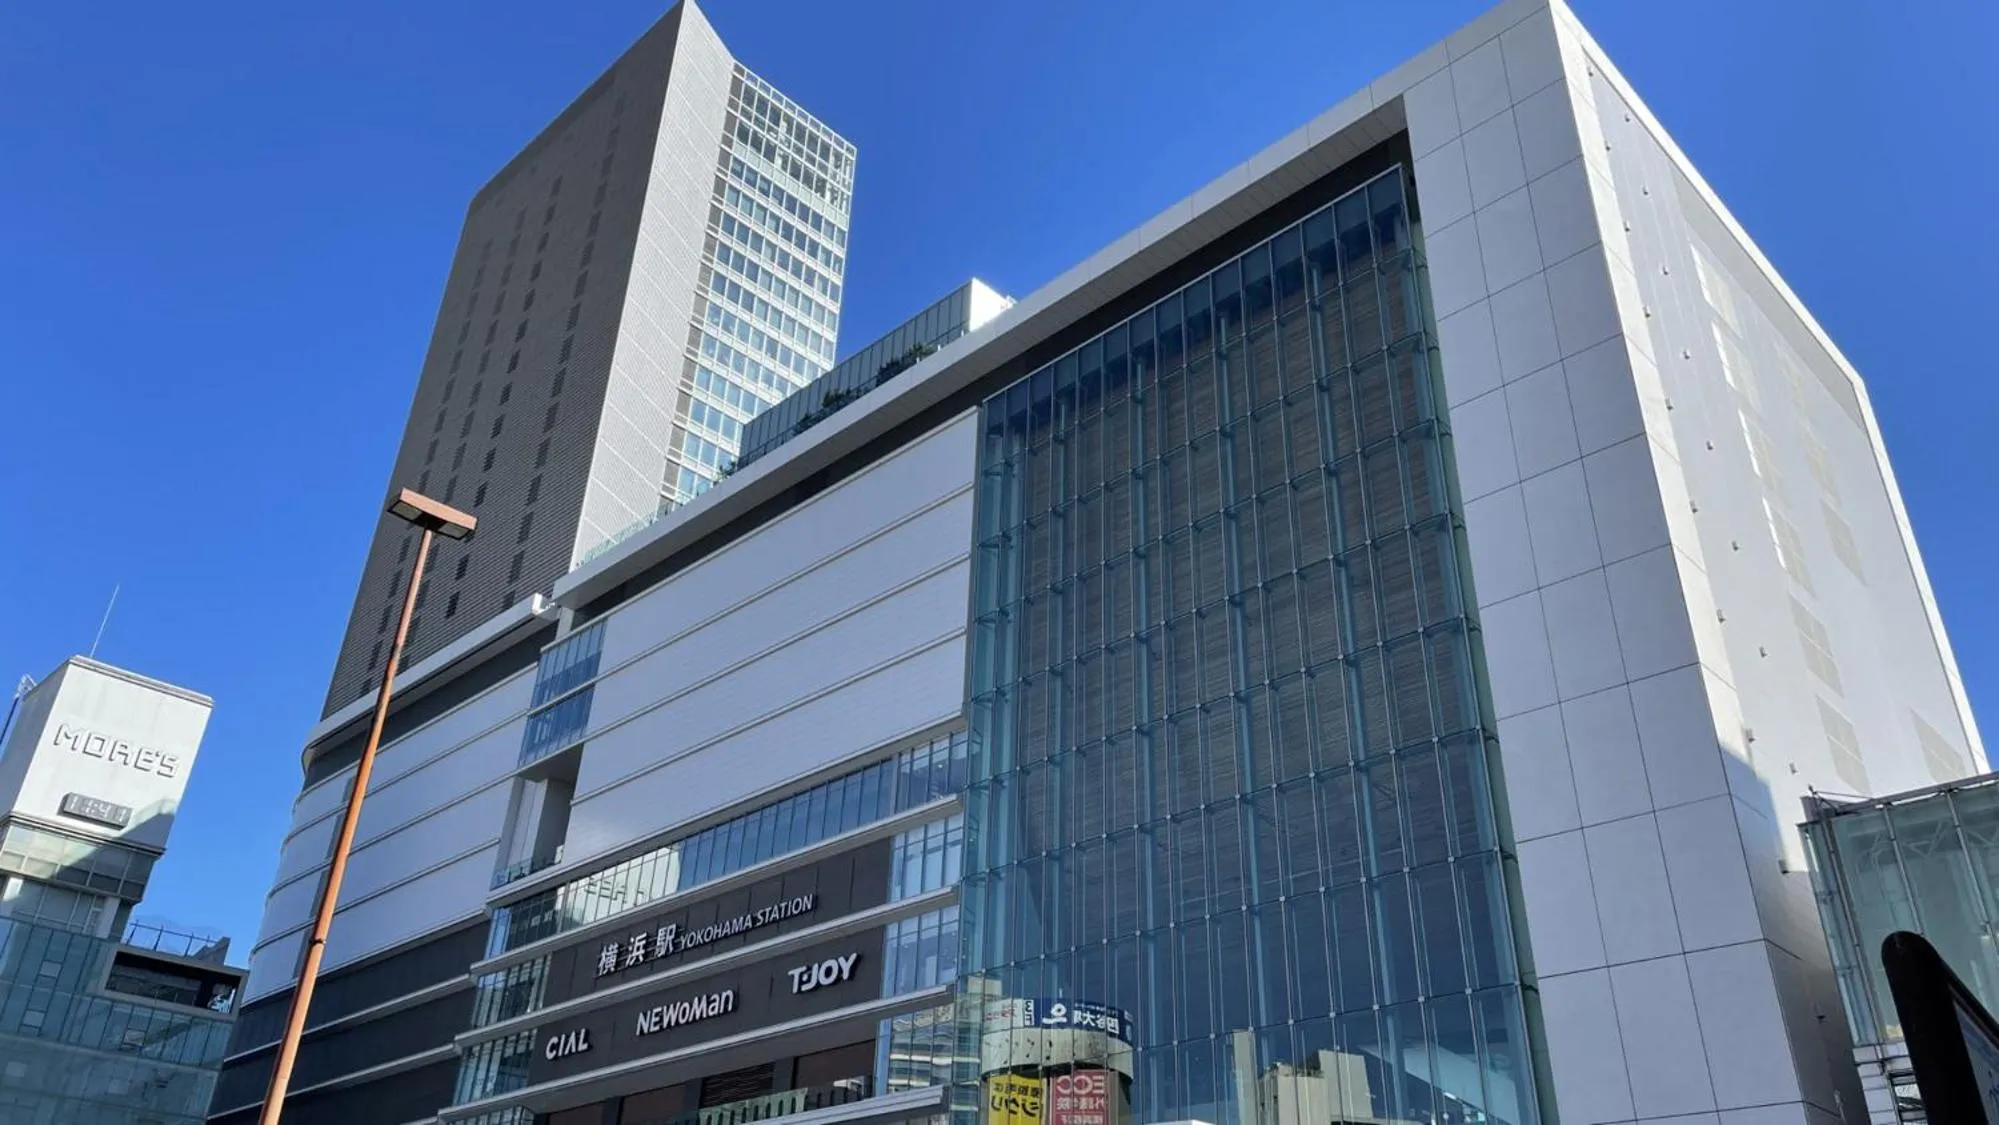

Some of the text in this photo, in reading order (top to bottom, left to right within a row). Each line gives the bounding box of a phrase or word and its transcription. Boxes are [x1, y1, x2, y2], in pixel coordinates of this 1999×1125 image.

[53, 723, 180, 778] MORE'S
[597, 893, 814, 976] 横浜駅 YOKOHAMA STATION
[545, 1027, 589, 1060] CIAL
